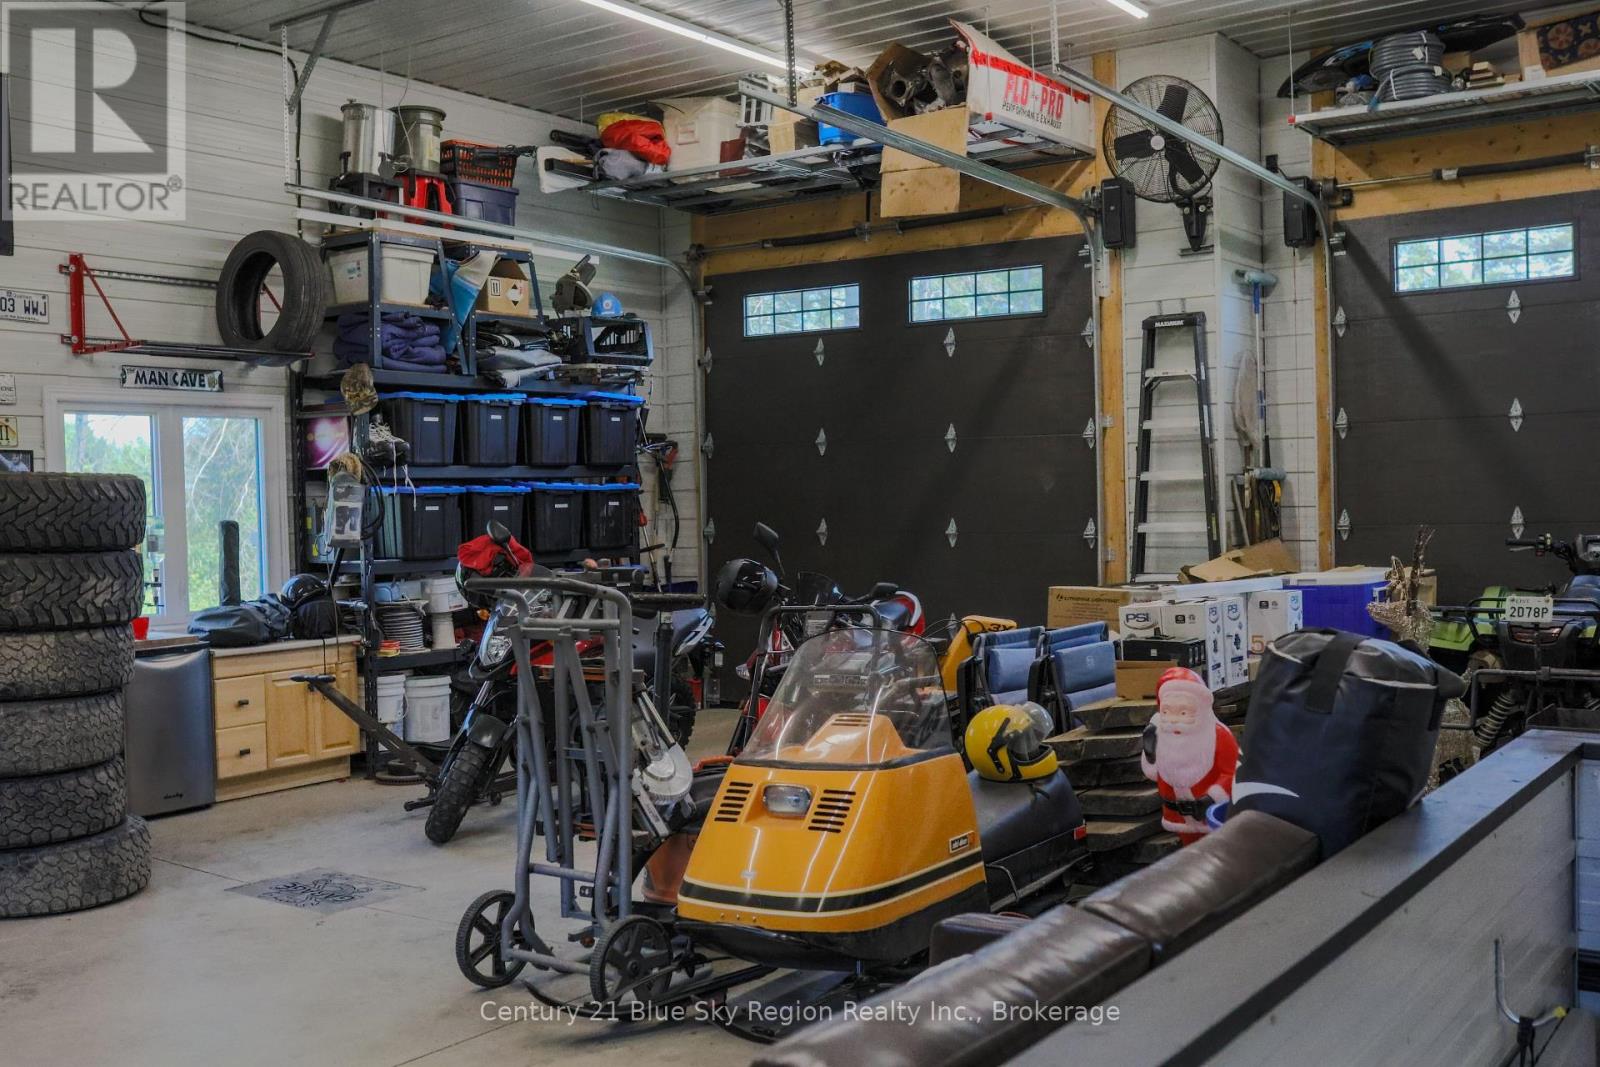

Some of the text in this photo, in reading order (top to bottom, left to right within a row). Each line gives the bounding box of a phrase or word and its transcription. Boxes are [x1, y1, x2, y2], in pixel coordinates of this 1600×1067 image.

[1040, 86, 1064, 121] PRO
[23, 300, 47, 316] WWJ
[134, 370, 206, 387] MAN CAVE
